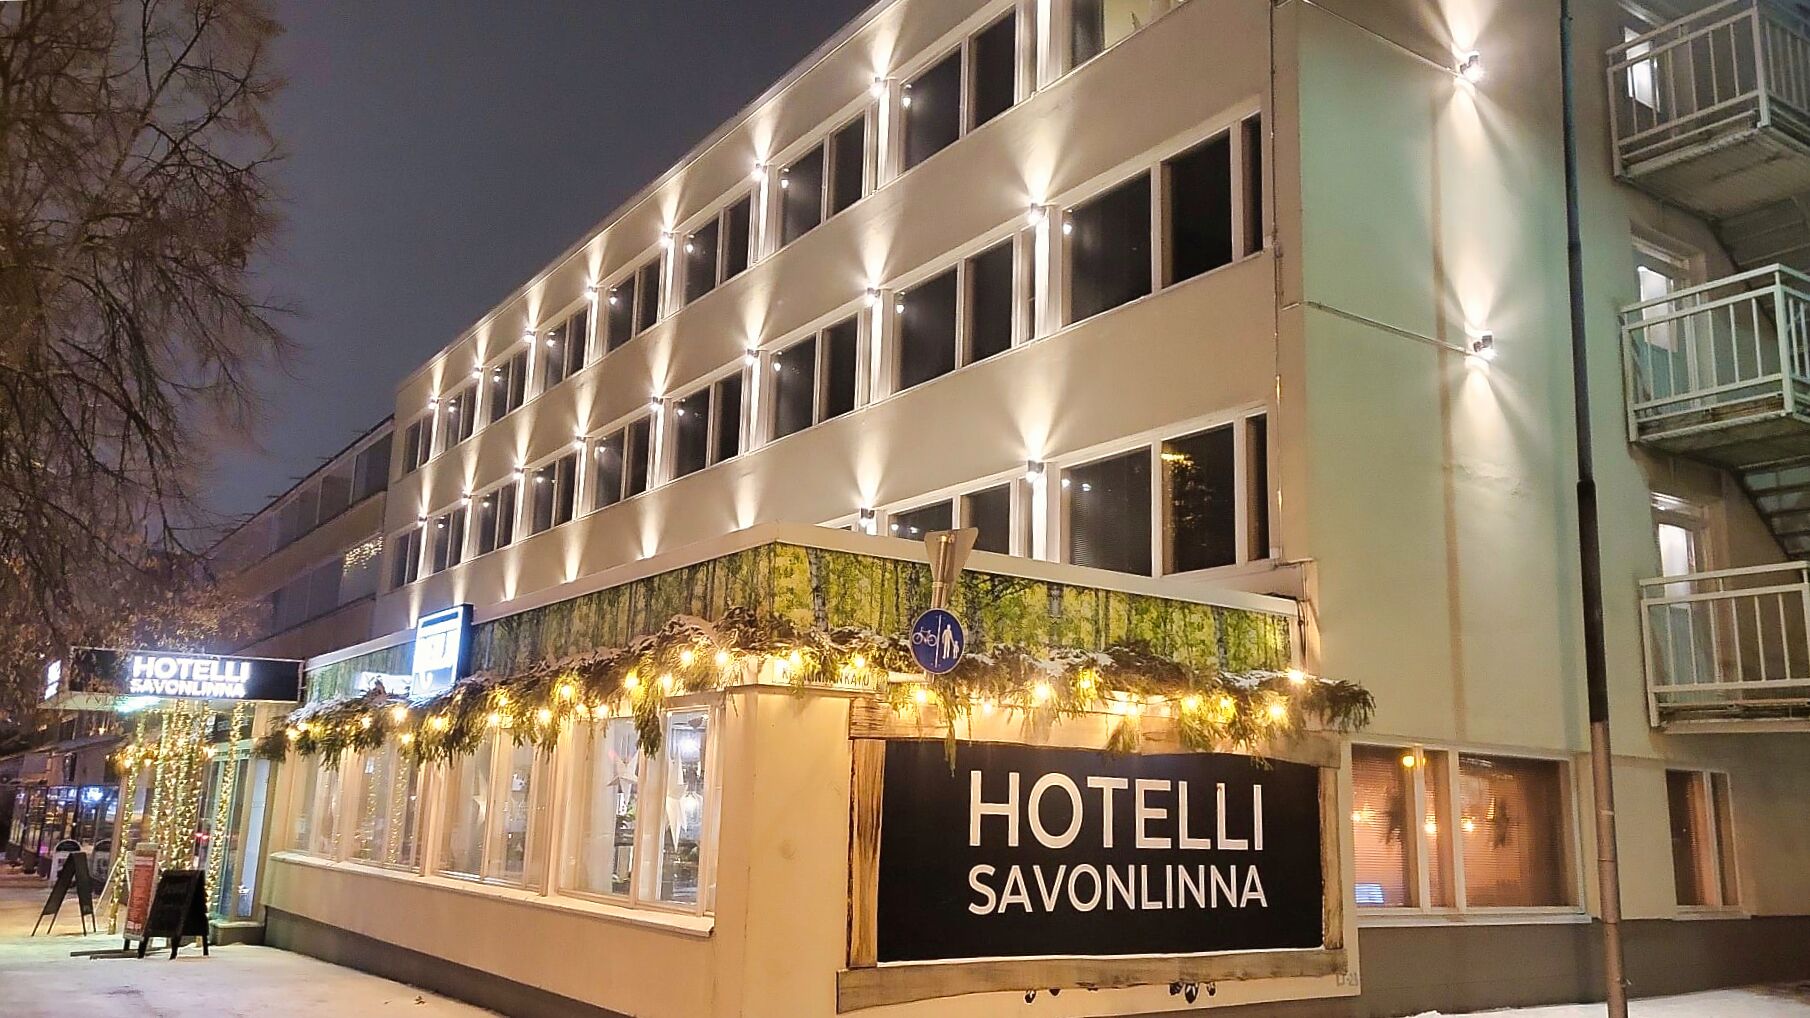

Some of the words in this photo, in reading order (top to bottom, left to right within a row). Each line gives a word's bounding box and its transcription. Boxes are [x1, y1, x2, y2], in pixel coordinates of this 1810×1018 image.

[130, 678, 246, 699] SAVONLINNA
[132, 656, 250, 683] HOTELLI
[969, 770, 1263, 851] HOTELLI
[968, 863, 1268, 916] SAVONLINNA
